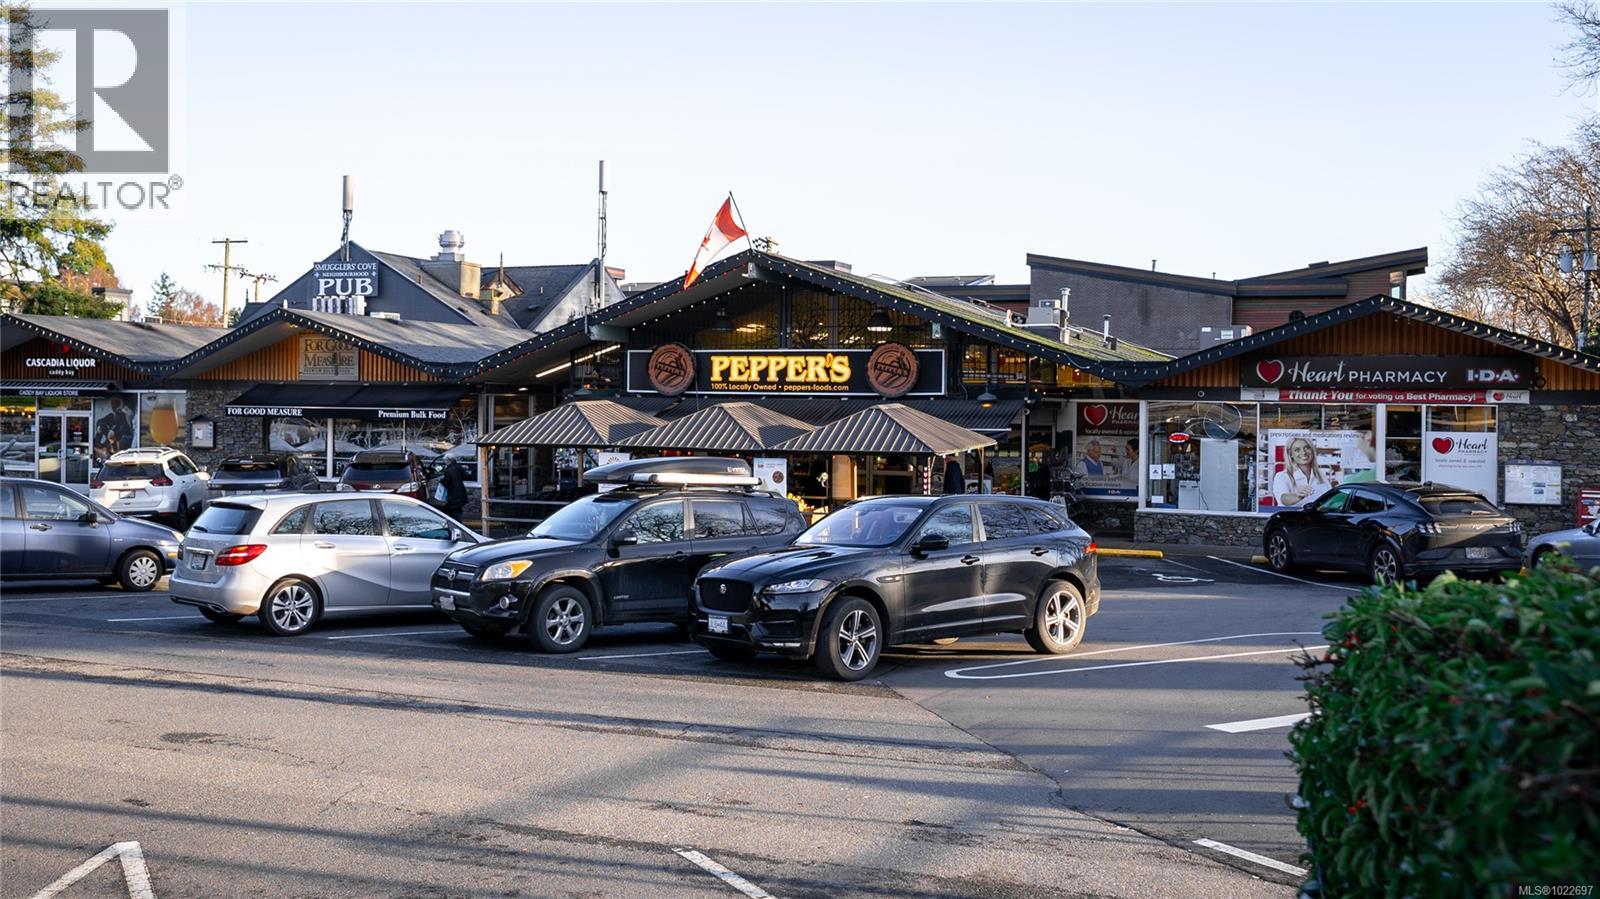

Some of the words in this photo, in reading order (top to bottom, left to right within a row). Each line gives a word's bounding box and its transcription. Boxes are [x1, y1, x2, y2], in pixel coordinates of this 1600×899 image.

[357, 262, 377, 270] COVE
[318, 277, 374, 296] PUB
[26, 358, 65, 367] CASCADIA
[66, 358, 96, 369] LIQUOR
[710, 353, 852, 383] PEPPER'S
[1288, 360, 1345, 383] Heart
[1349, 370, 1448, 383] PHARMACY
[728, 383, 751, 391] Locally
[1288, 390, 1328, 400] Thank
[1331, 390, 1353, 400] You
[1368, 392, 1393, 401] voting
[1406, 392, 1427, 400] Best
[1428, 393, 1476, 403] Pharmacy!
[227, 407, 242, 415] FOR
[243, 407, 266, 415] GOOD
[266, 408, 303, 416] MEASURE
[378, 410, 410, 418] Premium
[411, 410, 427, 418] Bulk
[428, 411, 446, 419] Food
[1456, 438, 1488, 450] Heart
